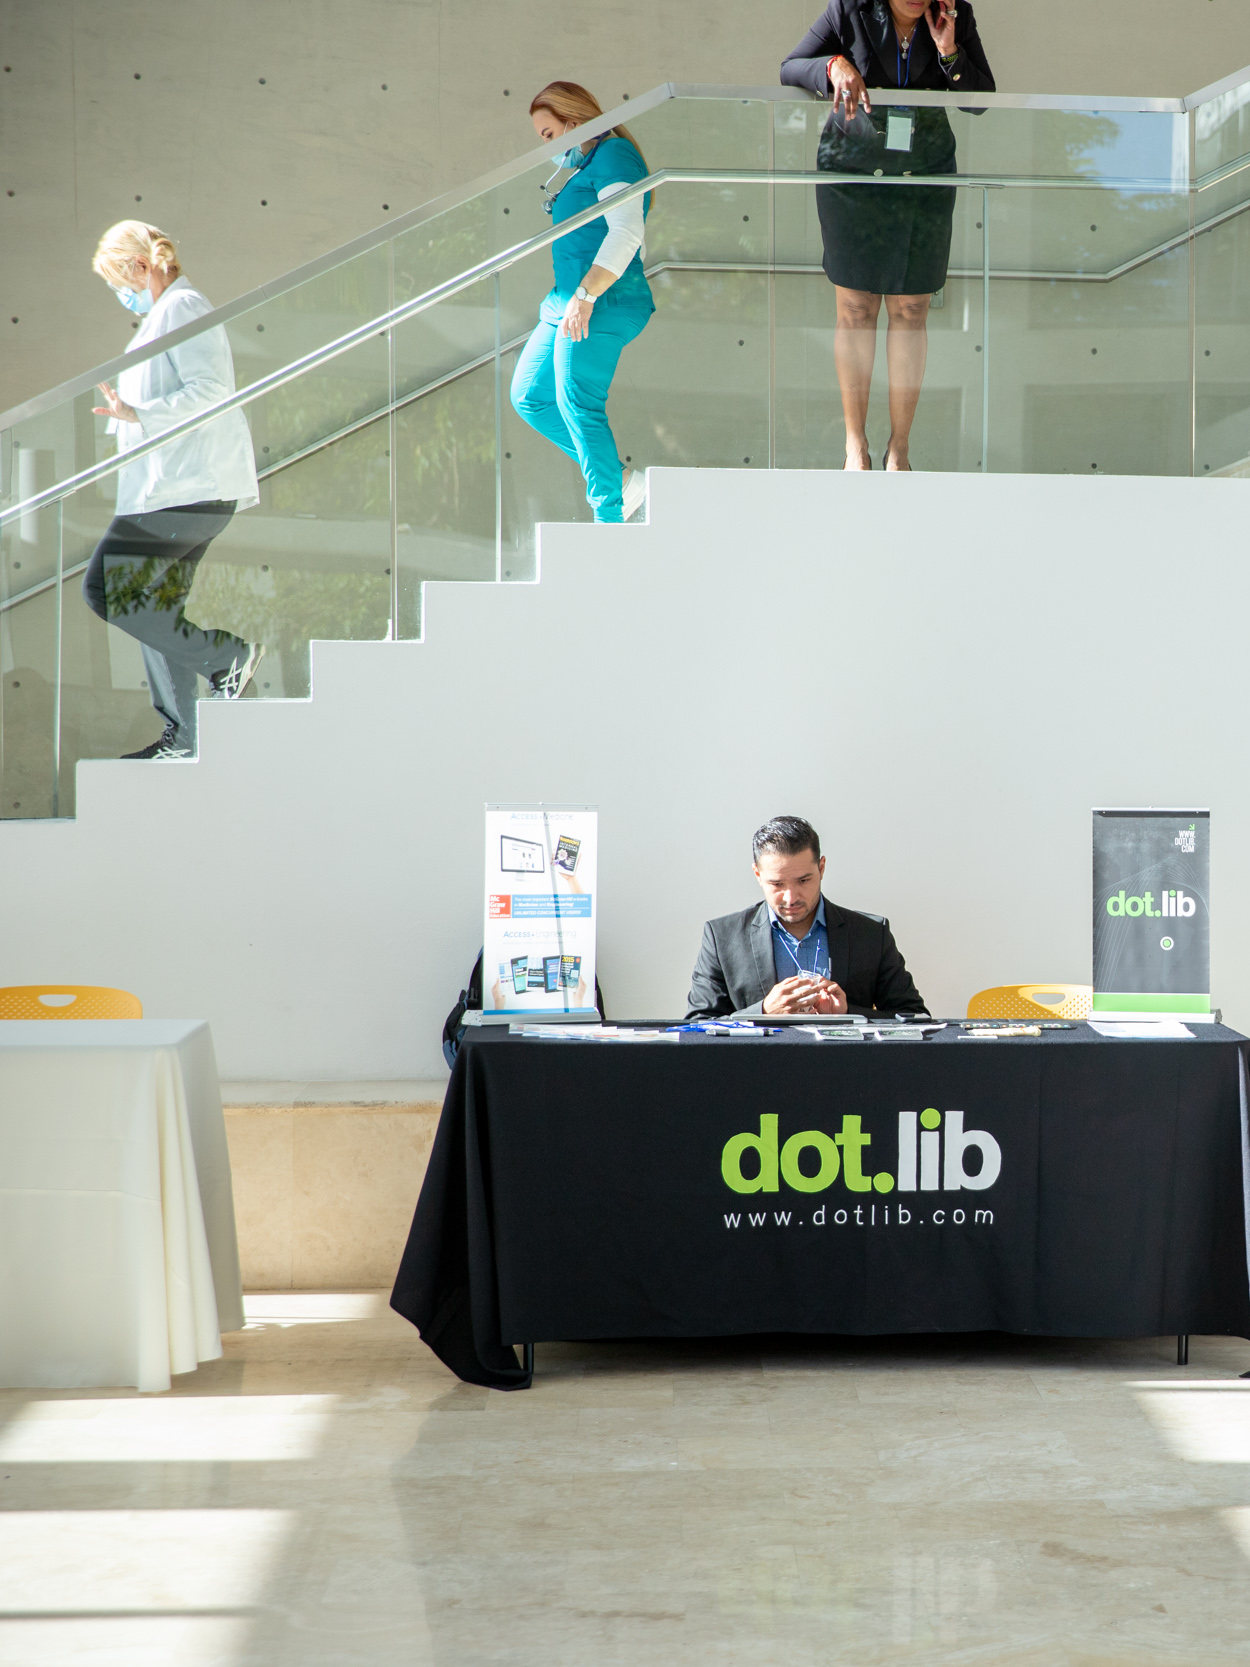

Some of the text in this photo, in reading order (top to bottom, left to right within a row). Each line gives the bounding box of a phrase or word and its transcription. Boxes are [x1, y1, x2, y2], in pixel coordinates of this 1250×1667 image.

[1106, 889, 1196, 918] dot.lib
[721, 1108, 1002, 1194] dot.lib
[723, 1204, 994, 1229] www.dotlib.com
